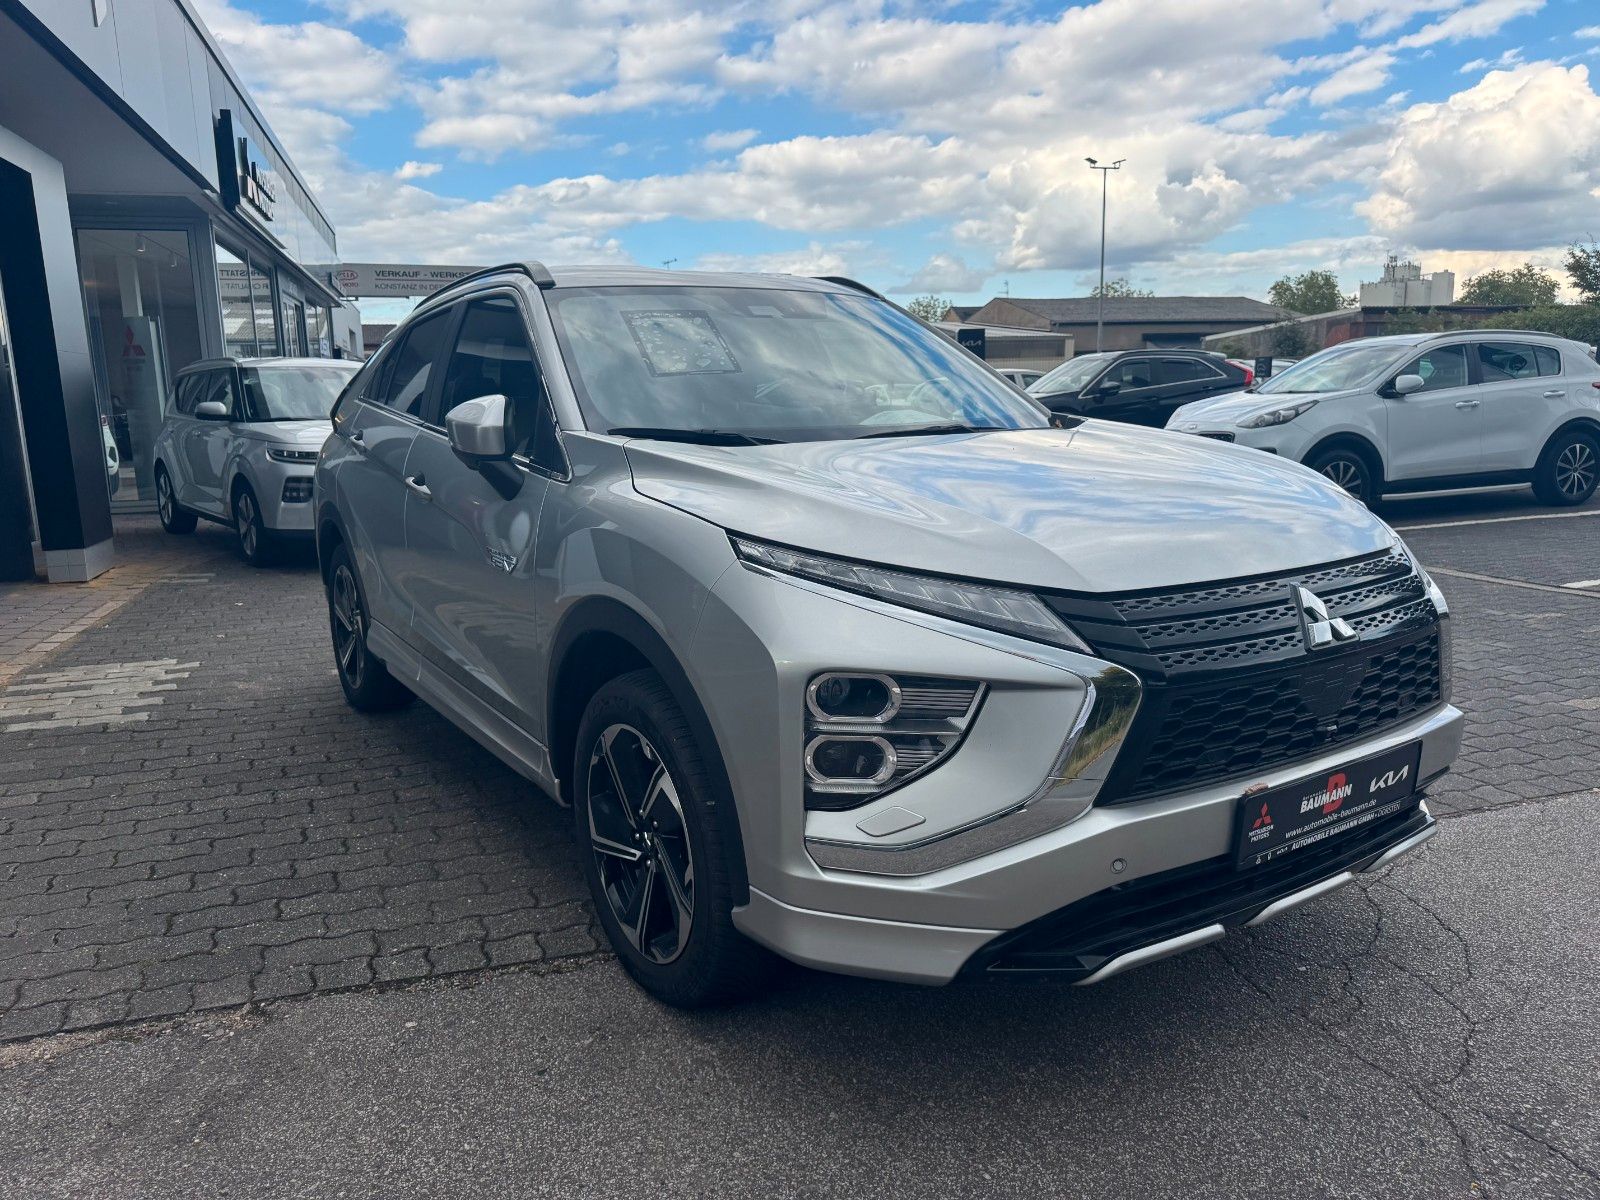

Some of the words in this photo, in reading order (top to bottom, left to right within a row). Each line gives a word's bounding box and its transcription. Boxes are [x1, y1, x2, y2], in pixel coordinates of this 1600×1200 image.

[374, 270, 420, 278] VERKAUF
[374, 283, 418, 291] KONSTANZ
[1369, 764, 1409, 793] KIA
[1300, 783, 1353, 814] BAUMANN
[1285, 798, 1377, 839] www.automobile-baumann.de
[1291, 829, 1330, 851] AUTOMOBILE
[1329, 820, 1359, 836] BAUMANN
